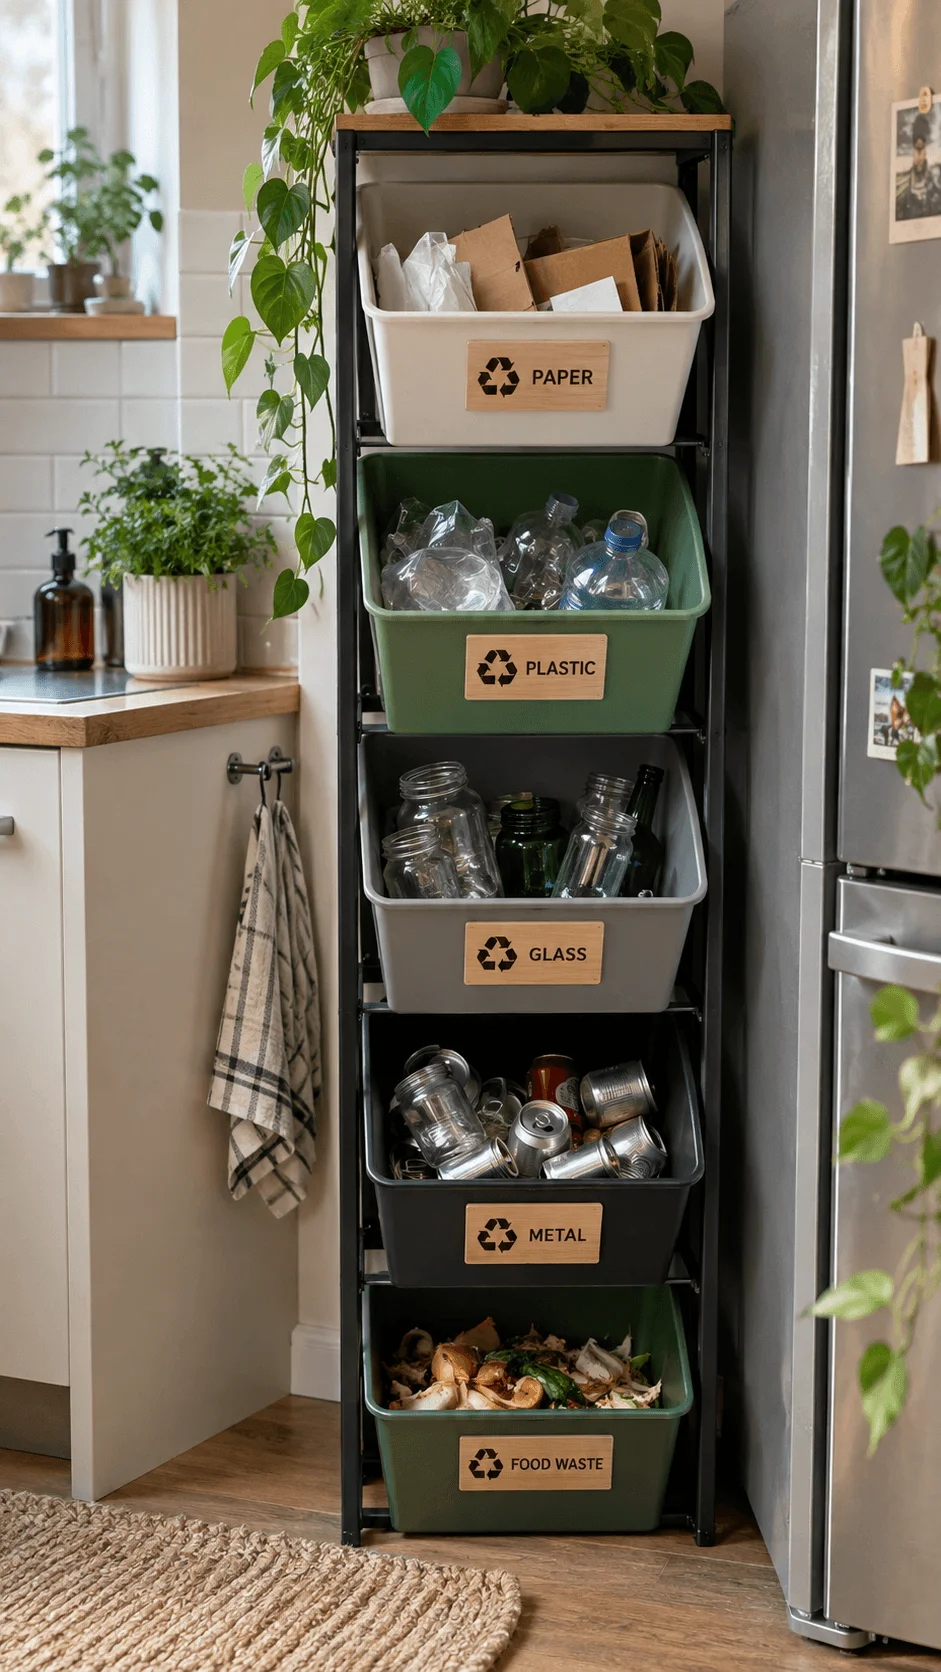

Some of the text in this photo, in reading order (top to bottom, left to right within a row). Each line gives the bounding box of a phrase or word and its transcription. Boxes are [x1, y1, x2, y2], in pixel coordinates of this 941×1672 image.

[532, 369, 593, 385] PAPER
[526, 661, 596, 675] PLASTIC
[529, 947, 587, 961] GLASS
[529, 1228, 586, 1242] METAL
[511, 1458, 604, 1470] FOOD WASTE
